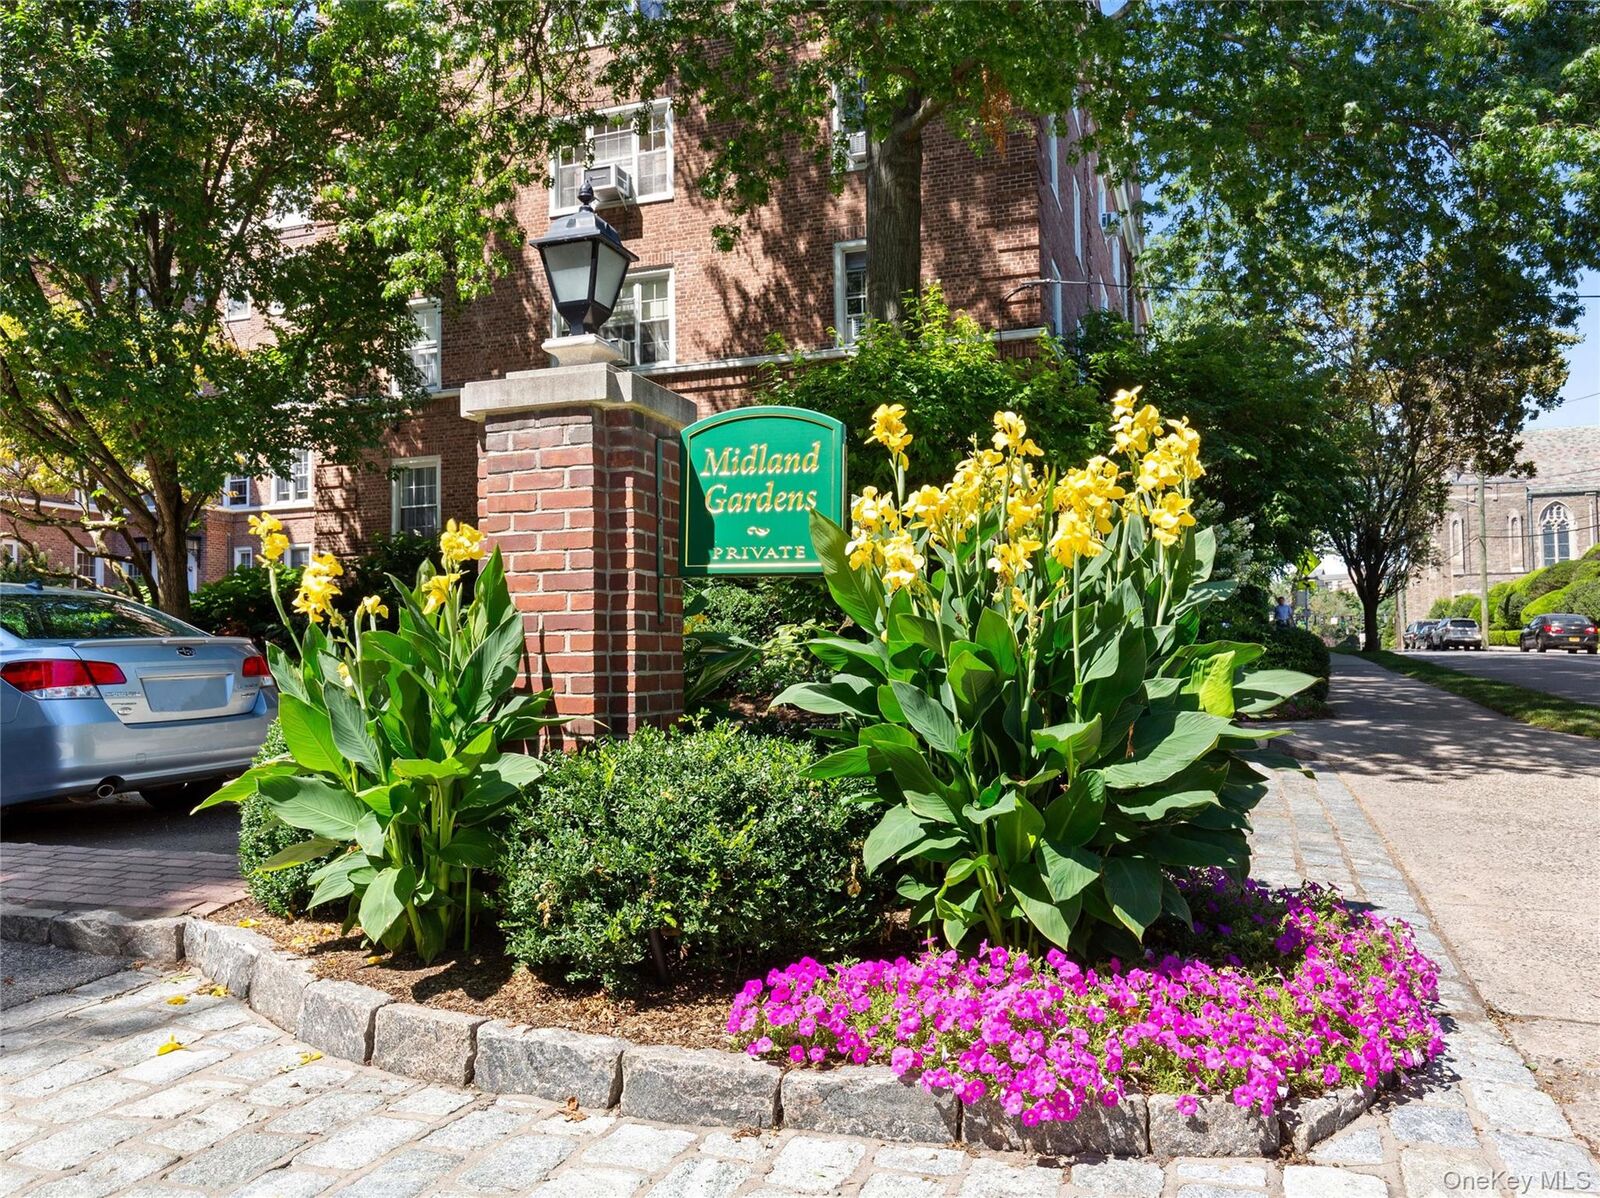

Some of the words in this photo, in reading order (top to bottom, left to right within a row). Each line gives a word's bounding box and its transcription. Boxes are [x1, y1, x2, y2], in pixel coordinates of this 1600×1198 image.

[700, 441, 821, 476] Midland
[705, 481, 817, 514] Gardens
[712, 545, 806, 560] PRIVATE
